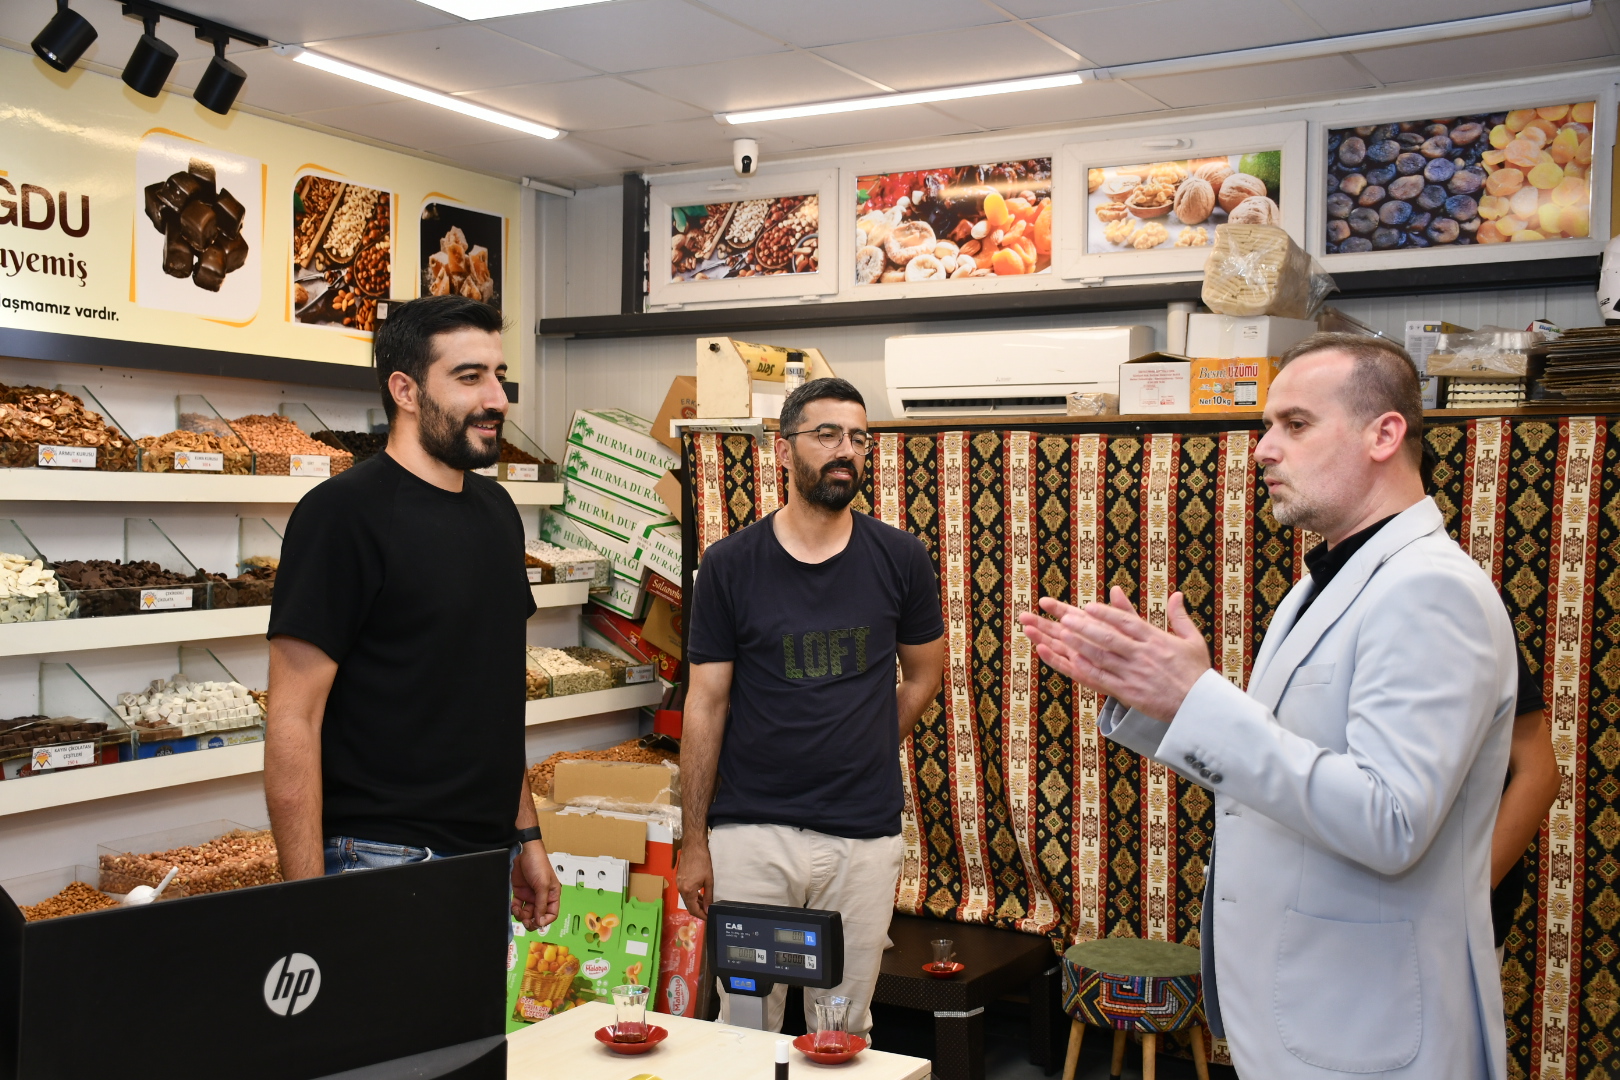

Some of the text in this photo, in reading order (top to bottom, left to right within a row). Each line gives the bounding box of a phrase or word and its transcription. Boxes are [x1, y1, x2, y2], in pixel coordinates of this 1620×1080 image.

[0, 294, 120, 321] aşmamız vardır.
[1228, 363, 1258, 378] ÜZÜMÜ
[1213, 395, 1222, 404] 10
[1223, 398, 1231, 406] kg
[596, 433, 676, 470] HURMA DURAĞI
[591, 466, 627, 489] HURMA
[579, 500, 614, 523] HURMA
[655, 541, 682, 562] HURM
[782, 626, 870, 679] LOFT
[725, 922, 743, 931] CAS
[807, 935, 814, 943] TL
[272, 953, 315, 1016] hp
[673, 978, 683, 1012] Malatya
[734, 980, 752, 988] CAS
